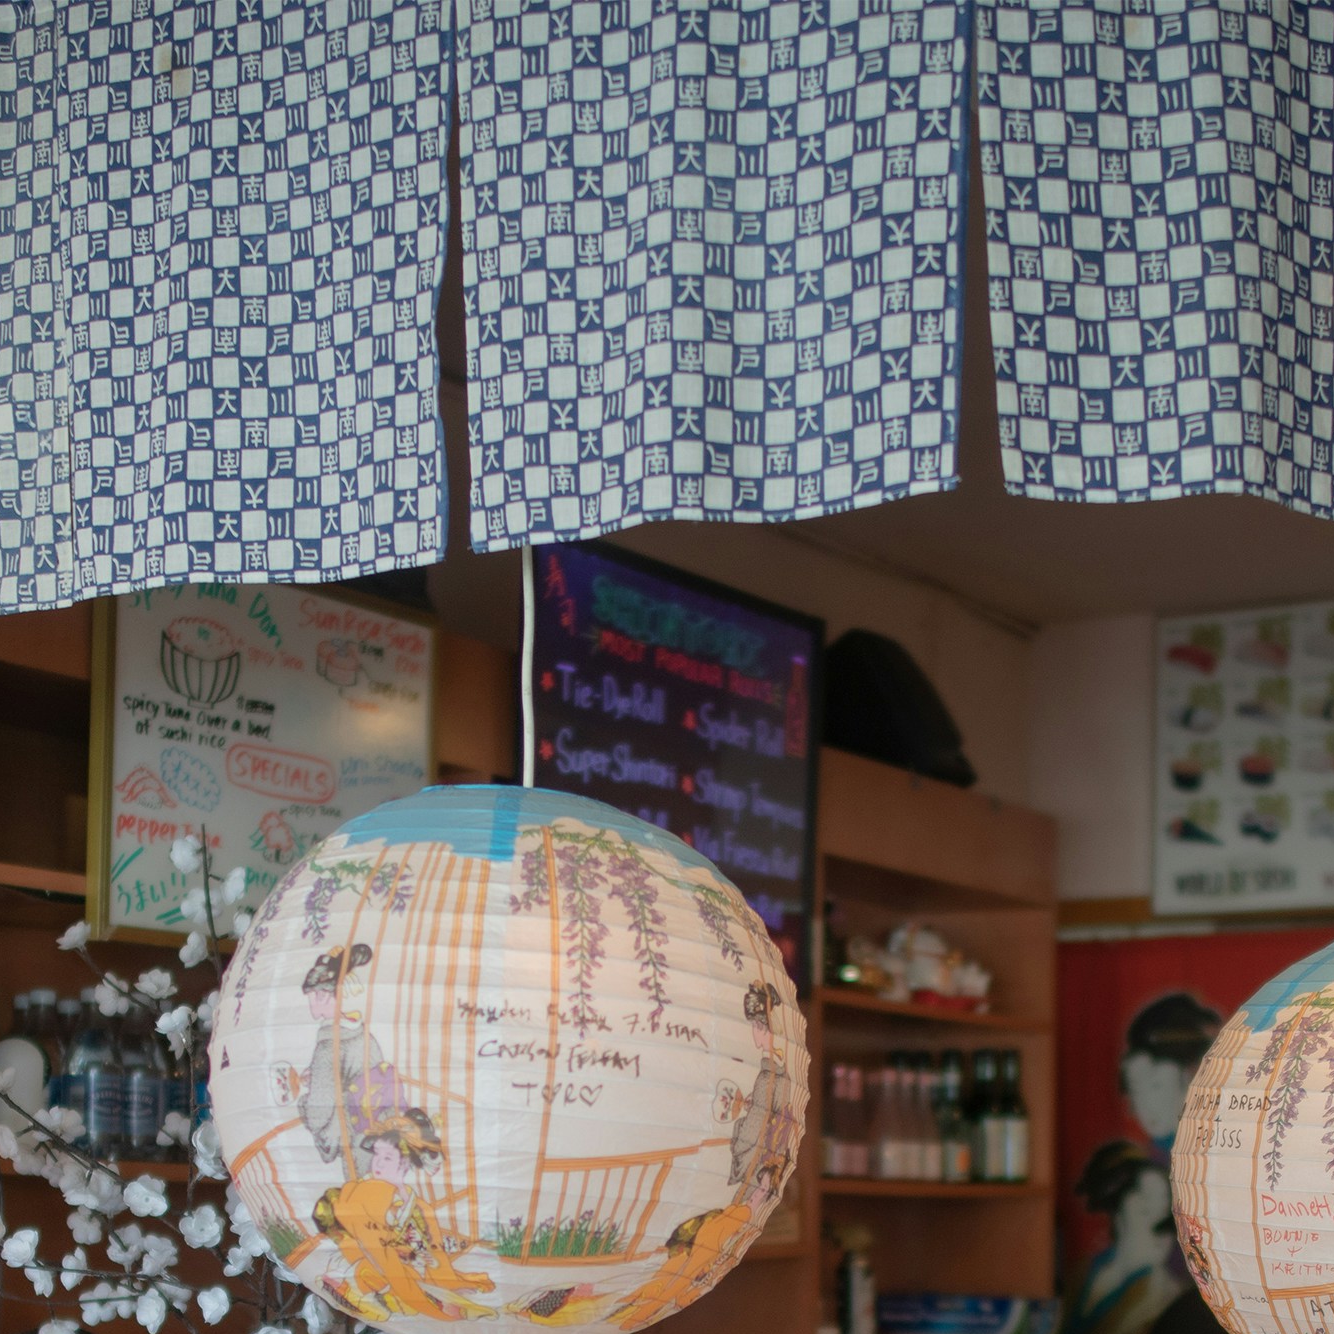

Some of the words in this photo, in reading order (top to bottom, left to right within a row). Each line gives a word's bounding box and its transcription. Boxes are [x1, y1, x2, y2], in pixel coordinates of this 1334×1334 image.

[681, 11, 704, 37] 大
[680, 144, 703, 171] 大
[770, 179, 793, 206] 南
[677, 277, 701, 303] 大
[234, 751, 327, 794] SPECIALS
[1229, 1095, 1272, 1111] BREAD
